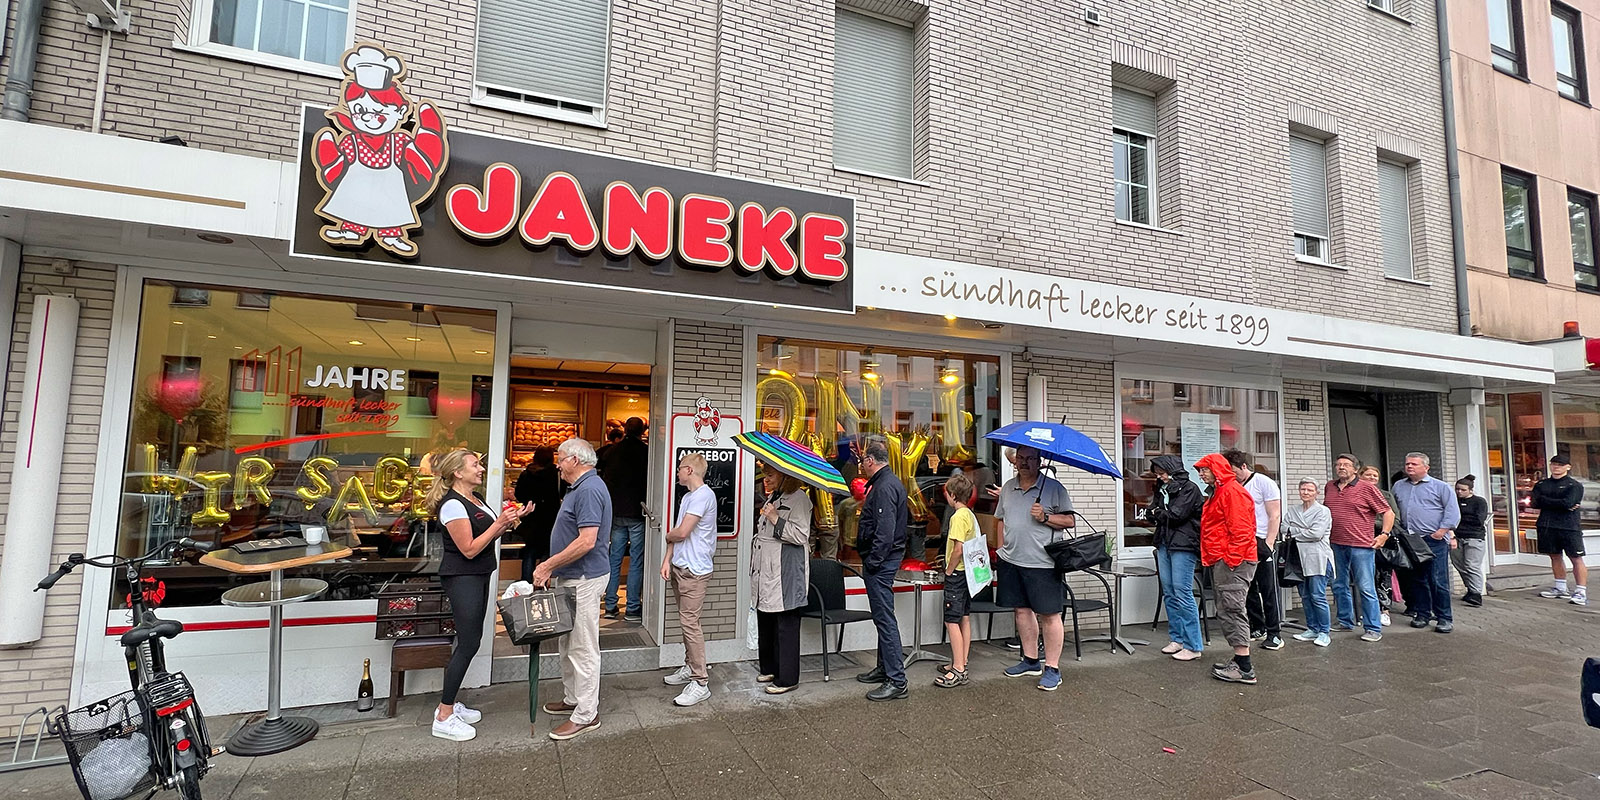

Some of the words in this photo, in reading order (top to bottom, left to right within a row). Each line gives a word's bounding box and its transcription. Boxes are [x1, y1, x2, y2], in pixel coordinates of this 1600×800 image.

[445, 161, 849, 283] JANEKE
[920, 270, 1070, 323] sündhaft
[1080, 289, 1158, 324] lecker
[1165, 302, 1208, 330] seit
[1215, 313, 1270, 347] 1899
[307, 364, 406, 391] JAHRE
[336, 411, 362, 423] seit
[364, 413, 399, 428] 1899
[360, 399, 402, 411] lecker
[140, 442, 276, 528] WIR
